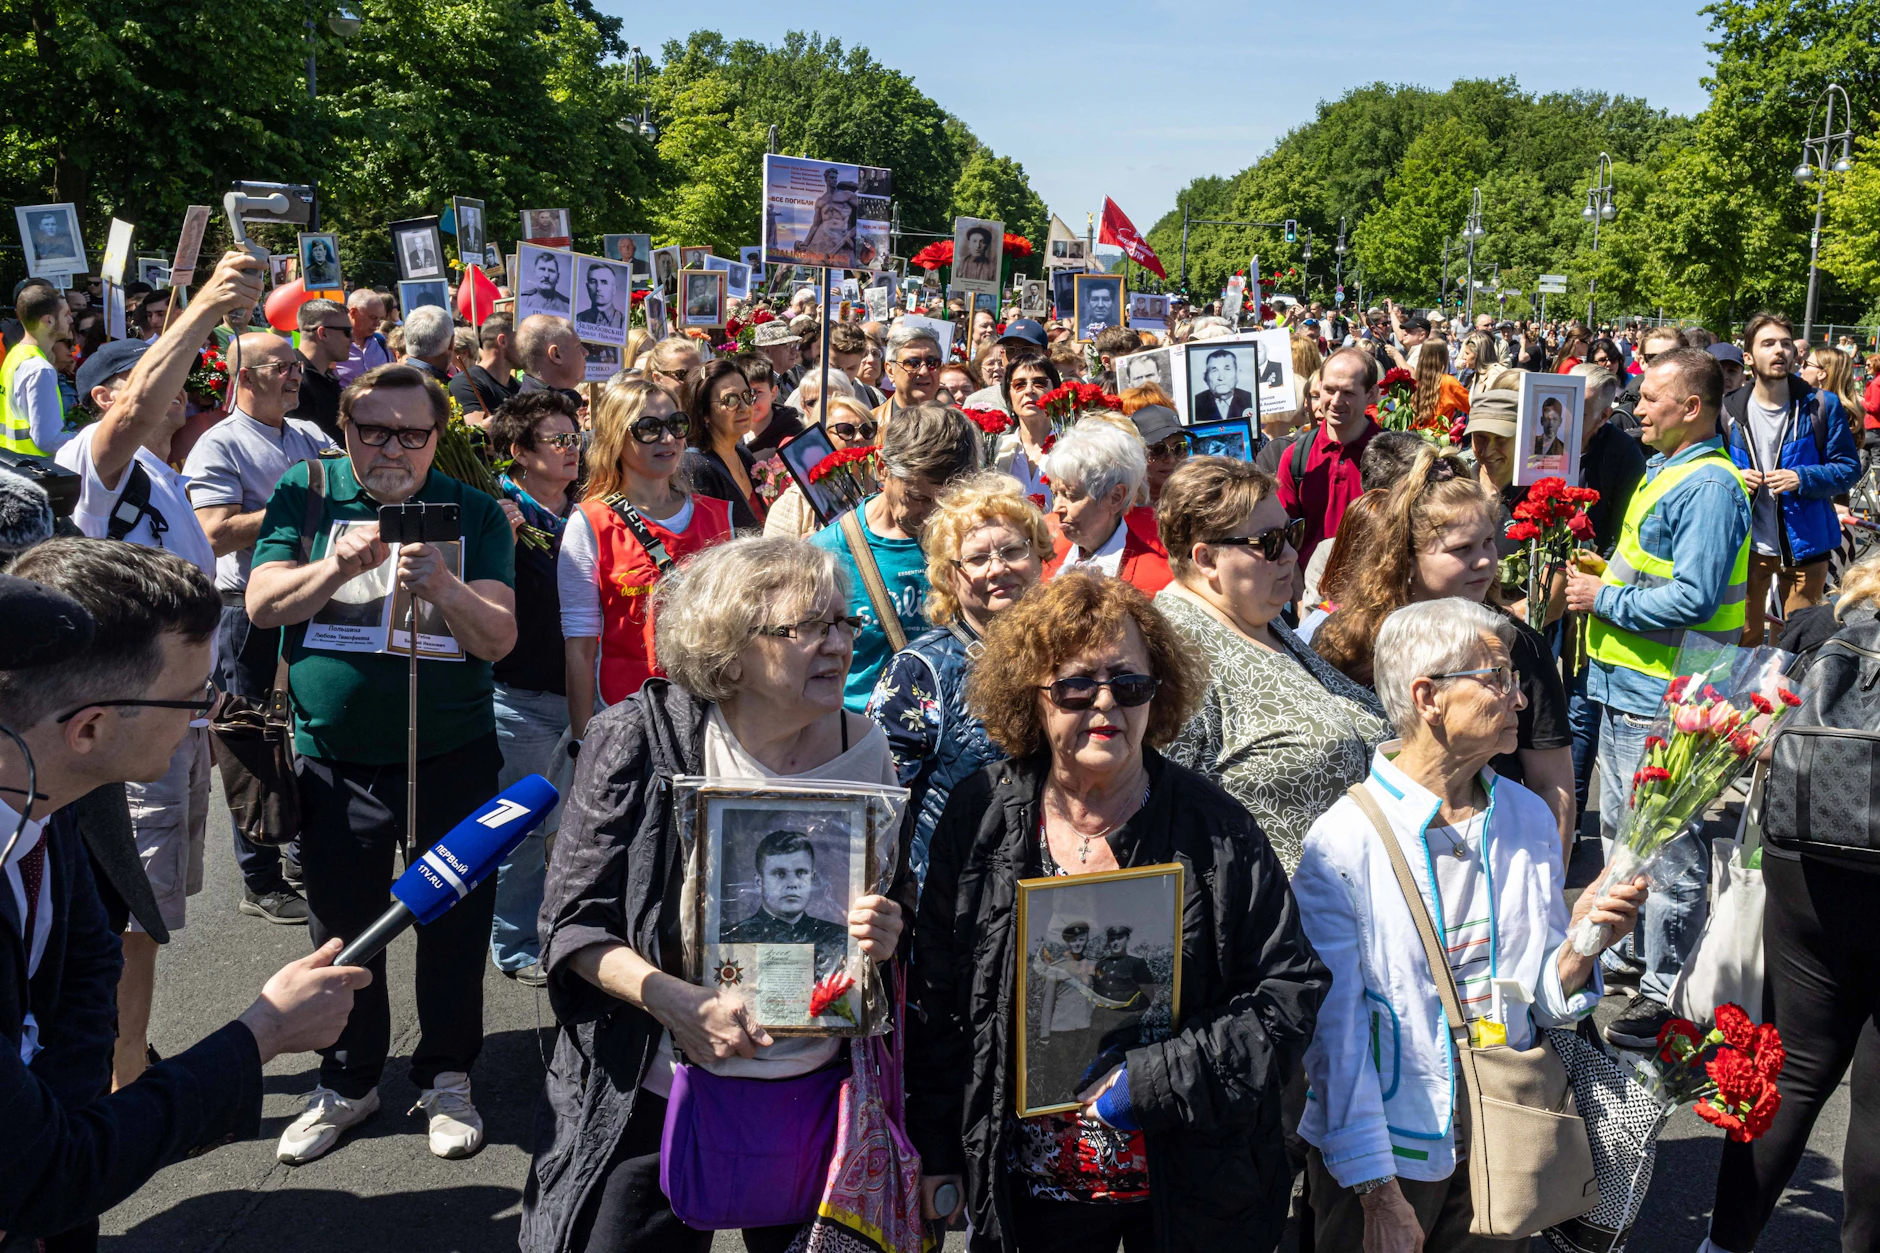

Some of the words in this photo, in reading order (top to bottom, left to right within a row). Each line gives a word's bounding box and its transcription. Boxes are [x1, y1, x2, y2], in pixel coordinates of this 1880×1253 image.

[784, 197, 814, 206] ПОГИБЛИ
[770, 248, 824, 260] STALINGRAD
[578, 322, 624, 336] Залюбовский
[435, 844, 468, 874] ПЕРВЫЙ
[418, 864, 444, 888] 1TV.RU
